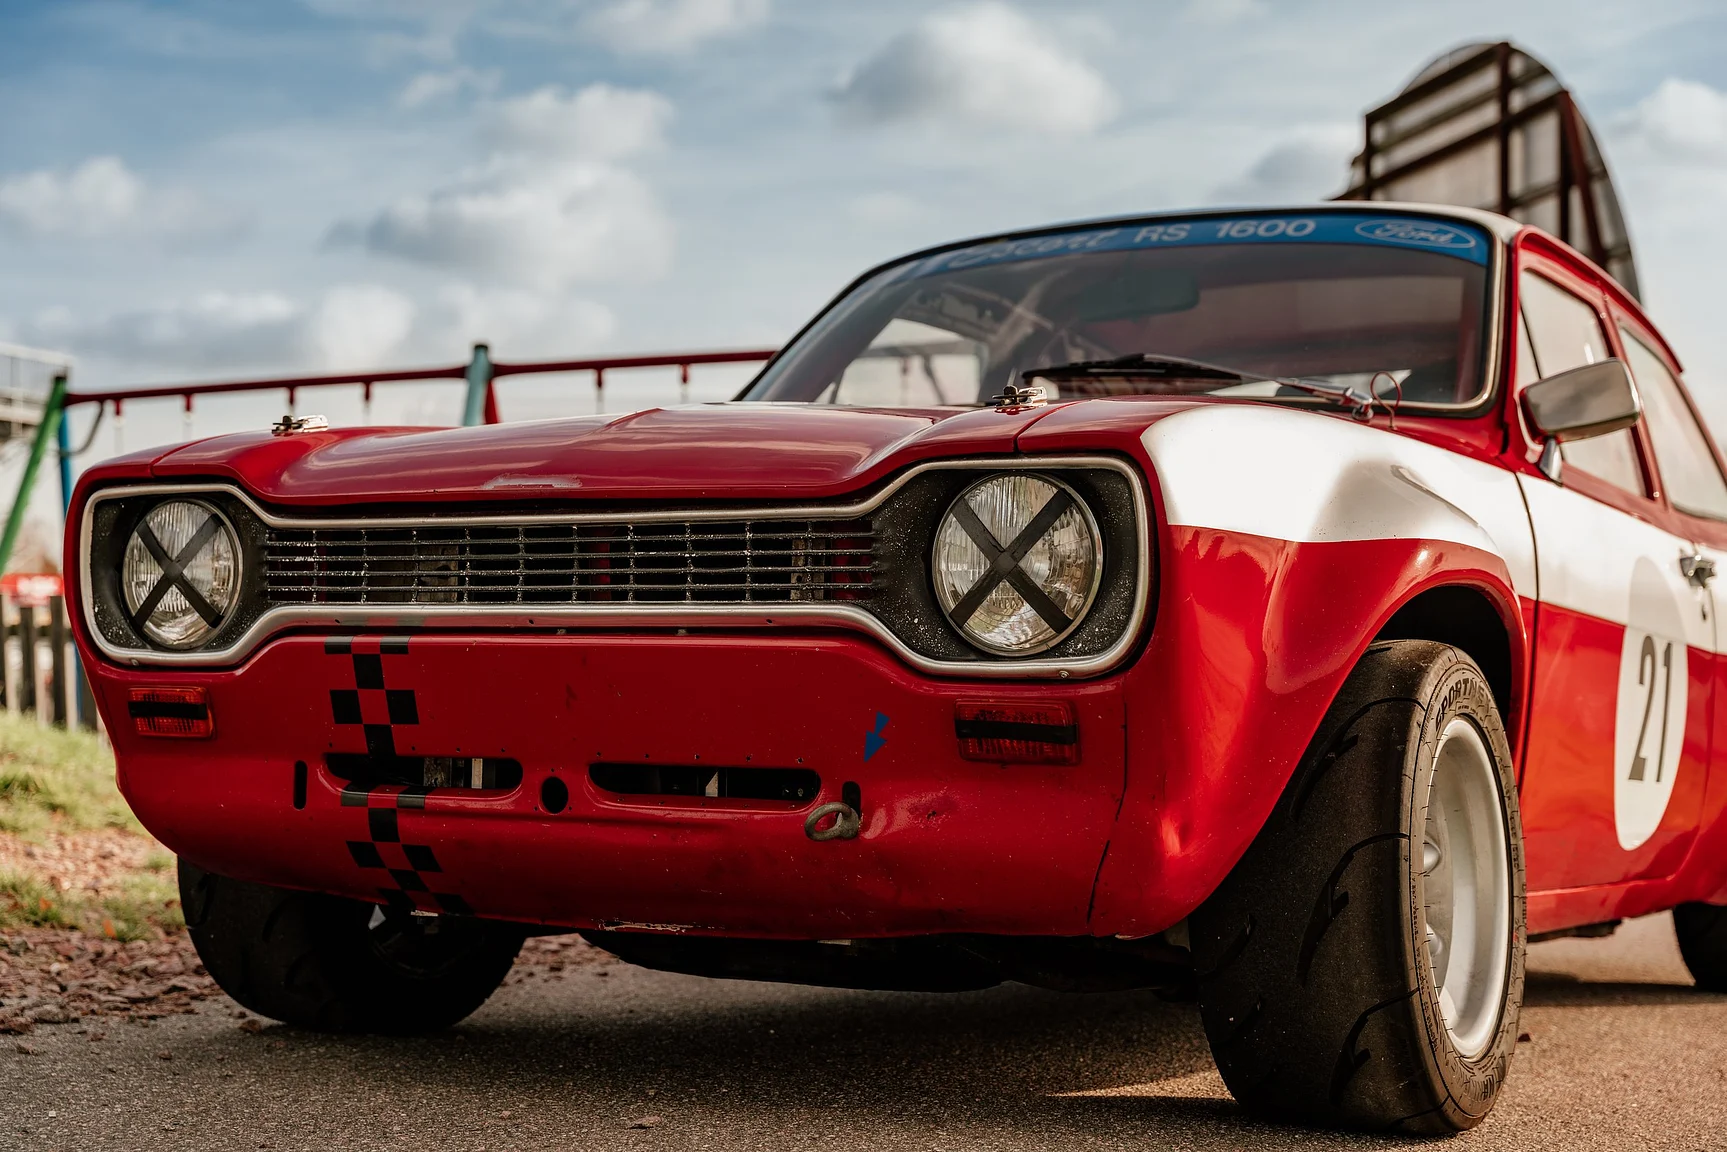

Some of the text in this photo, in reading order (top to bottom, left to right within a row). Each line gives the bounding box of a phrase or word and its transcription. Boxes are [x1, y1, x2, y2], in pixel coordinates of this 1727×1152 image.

[1133, 222, 1191, 243] RS
[1216, 218, 1316, 238] 1600
[1372, 220, 1457, 245] Ford
[1628, 635, 1672, 783] 21
